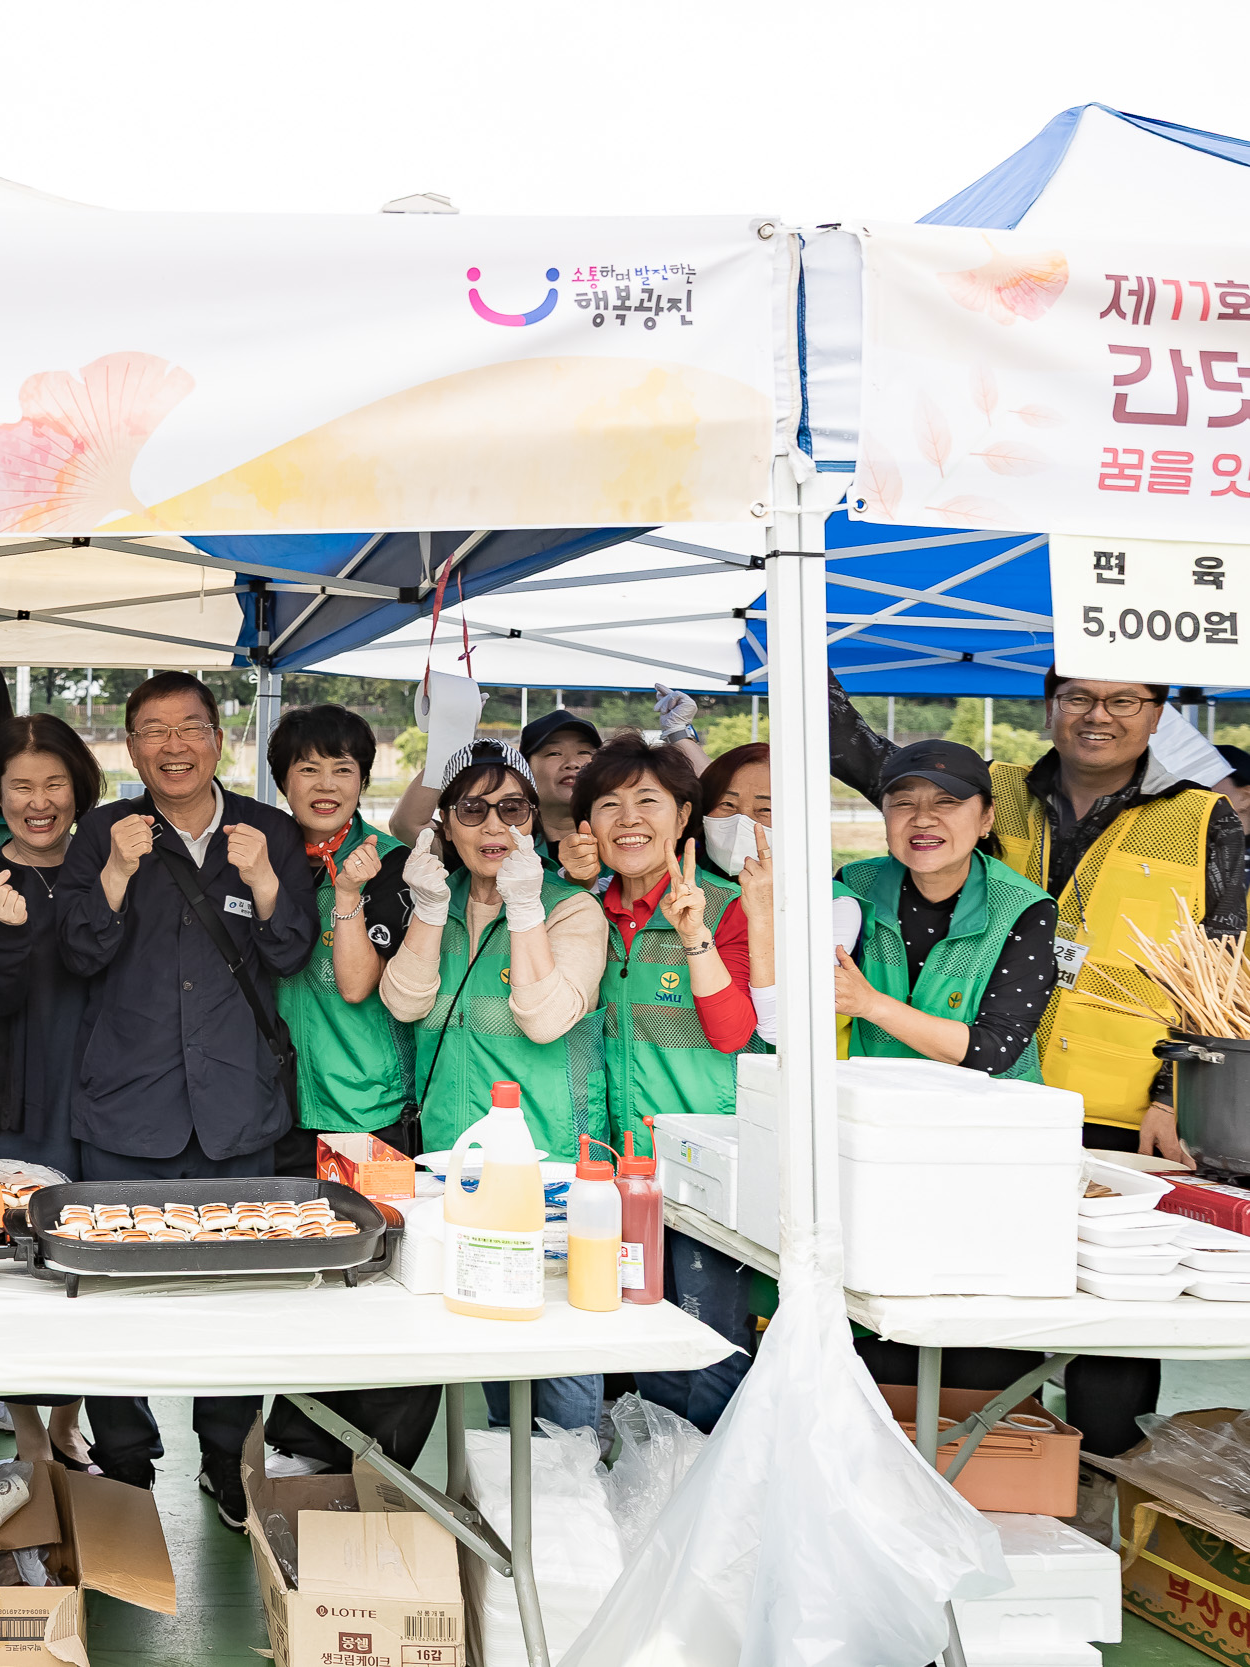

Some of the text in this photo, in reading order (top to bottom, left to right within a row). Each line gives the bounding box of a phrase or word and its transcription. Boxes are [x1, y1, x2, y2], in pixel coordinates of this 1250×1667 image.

[571, 263, 697, 289] 소통하며 발전하는
[574, 285, 693, 330] 행복광진
[1098, 447, 1195, 495] 꿈을
[1083, 605, 1238, 644] 5,000원
[654, 991, 682, 1003] SMU
[331, 1607, 377, 1619] LOTTE
[5, 1644, 41, 1652] 박스바코드
[342, 1636, 369, 1651] 몽쉘
[320, 1653, 391, 1667] 생크림케이크
[416, 1649, 442, 1661] 16갑
